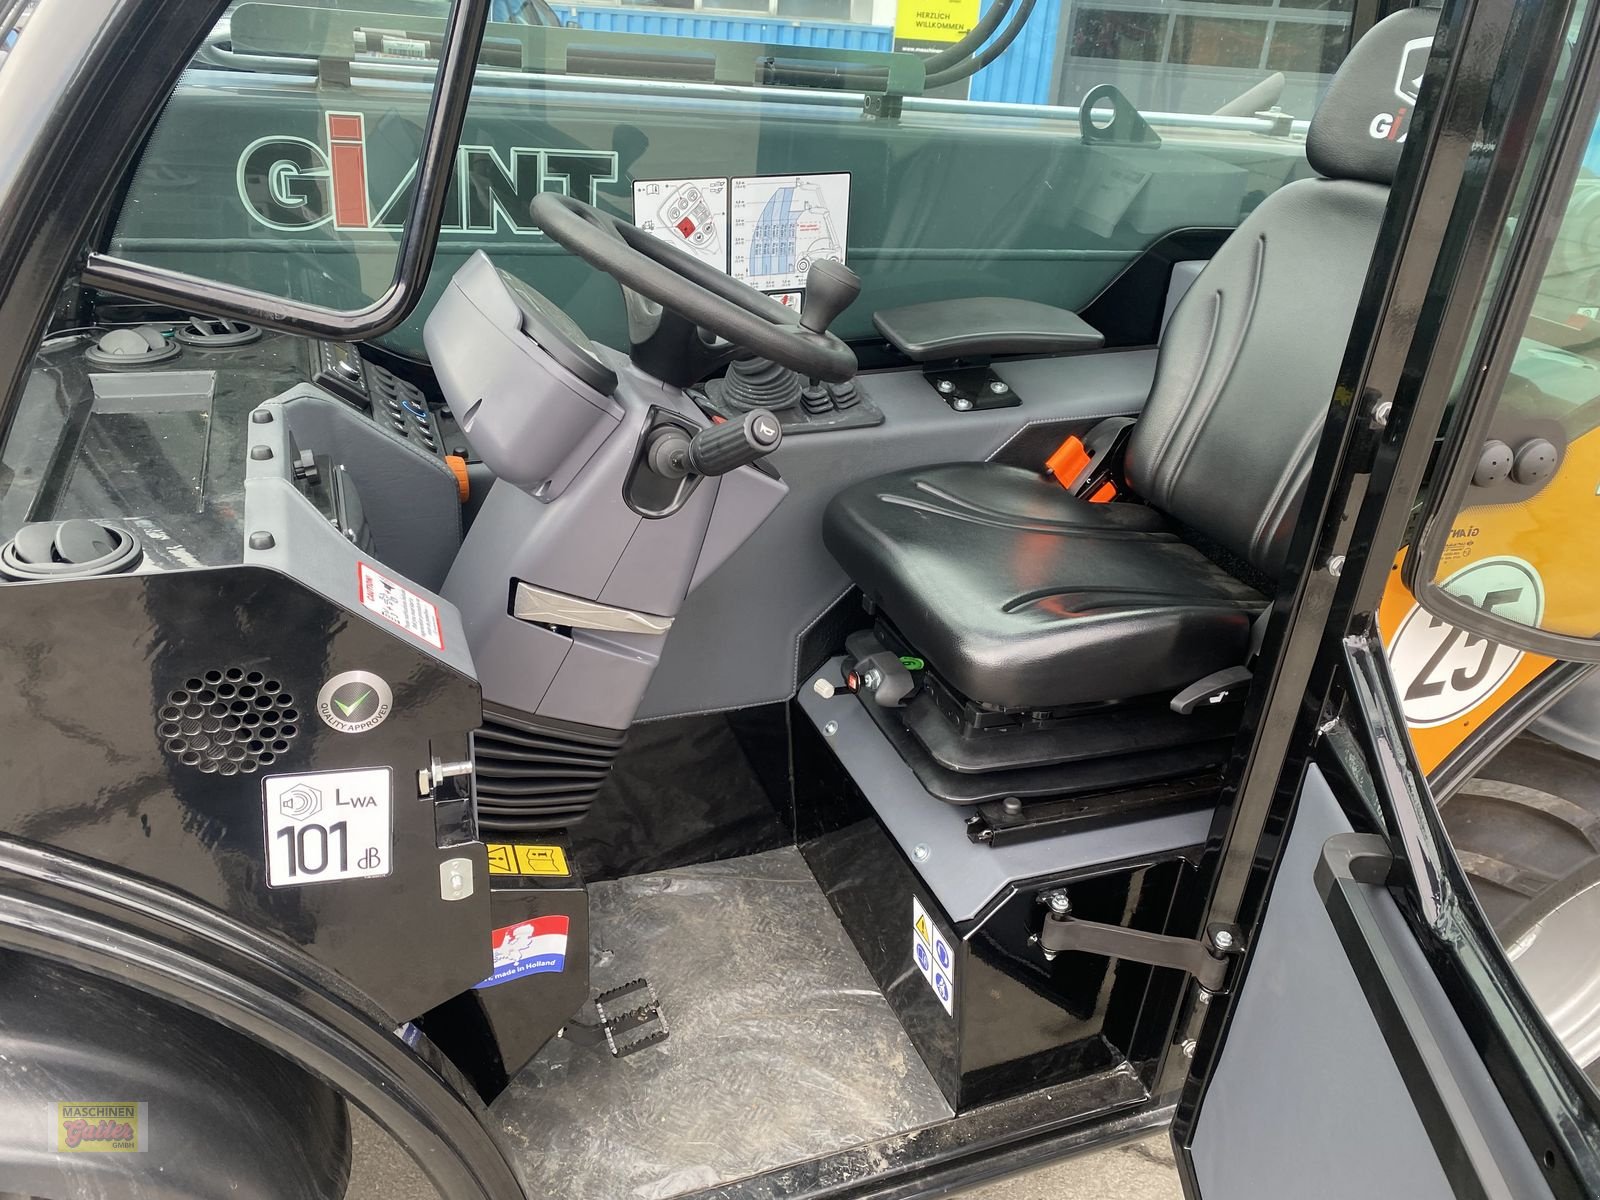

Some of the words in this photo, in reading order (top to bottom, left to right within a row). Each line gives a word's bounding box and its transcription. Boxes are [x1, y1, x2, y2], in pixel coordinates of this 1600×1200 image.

[916, 12, 950, 20] HERZLICH
[916, 21, 964, 30] WILLKOMMEN
[1404, 587, 1524, 701] 25
[321, 702, 347, 730] QUALITY
[347, 704, 388, 731] APPROVED
[277, 820, 348, 877] 101
[357, 847, 381, 869] dB
[494, 969, 516, 980] made
[526, 960, 556, 970] Holland
